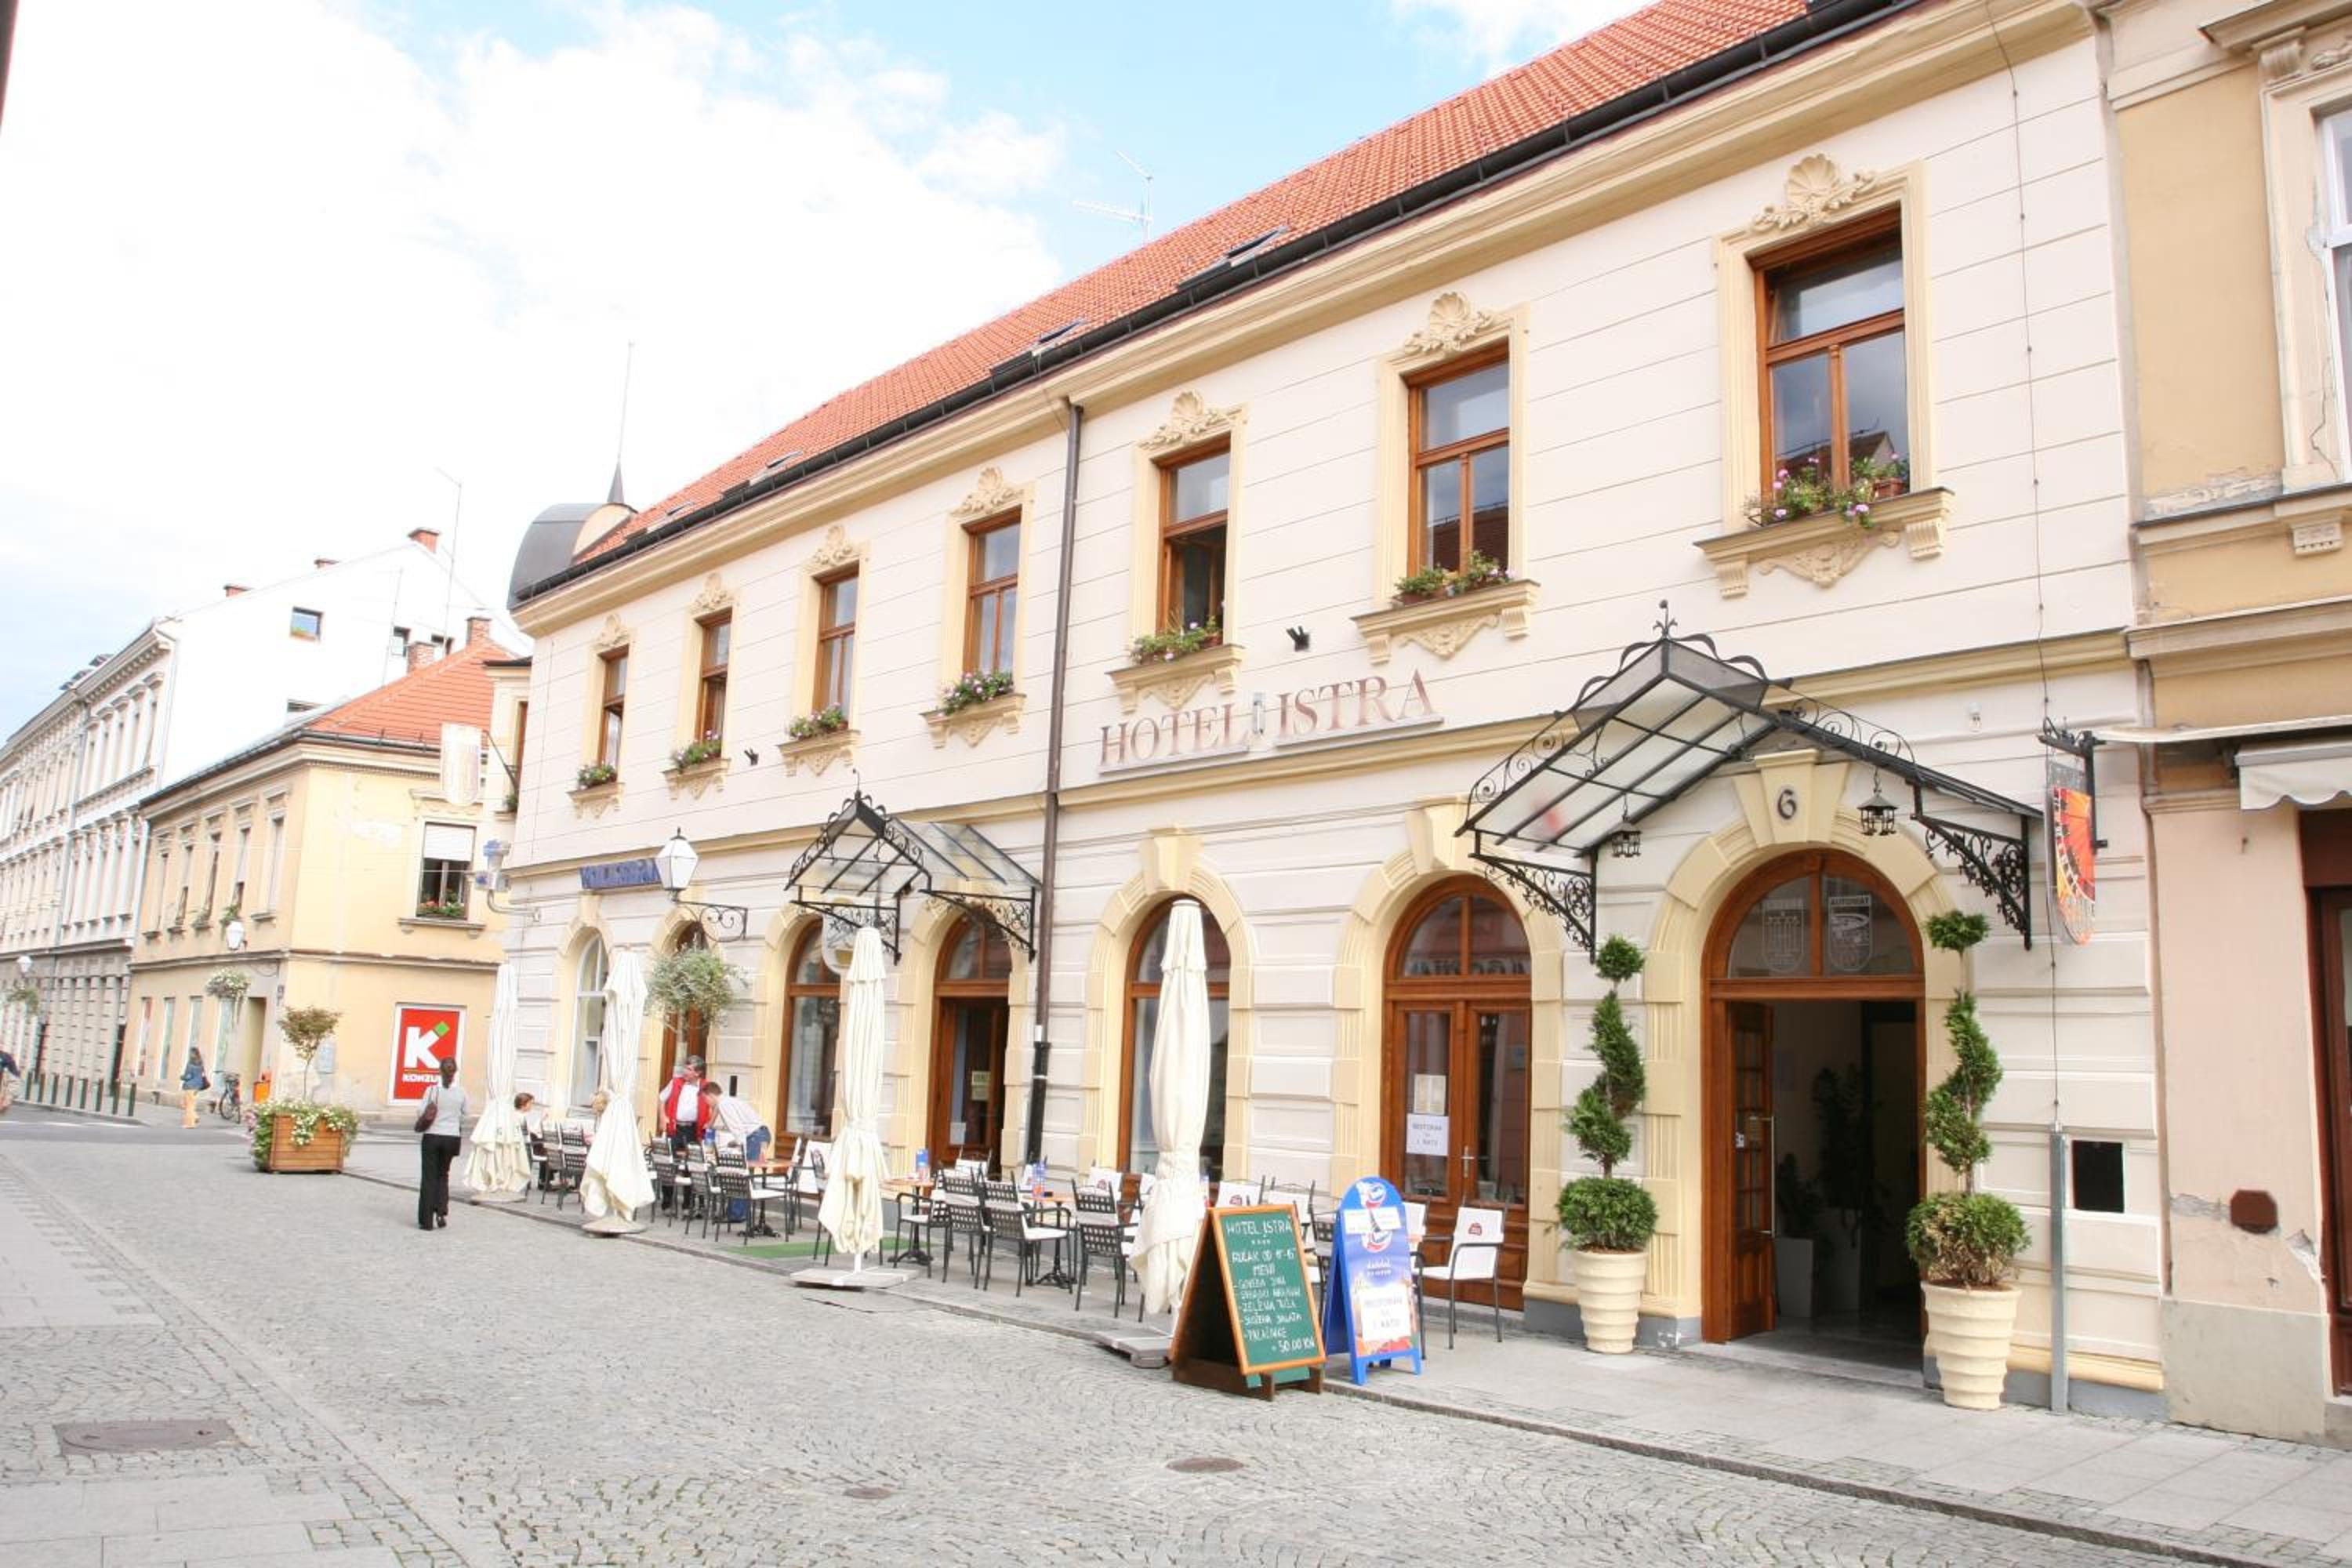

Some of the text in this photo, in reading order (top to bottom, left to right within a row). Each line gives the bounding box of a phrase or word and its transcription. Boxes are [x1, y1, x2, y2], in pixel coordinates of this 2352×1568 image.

[1100, 669, 1438, 766] HOTEL ISTRA
[1777, 788, 1797, 821] 6
[401, 1073, 441, 1082] KONZU
[1226, 1218, 1292, 1235] HOTEL ISTRA
